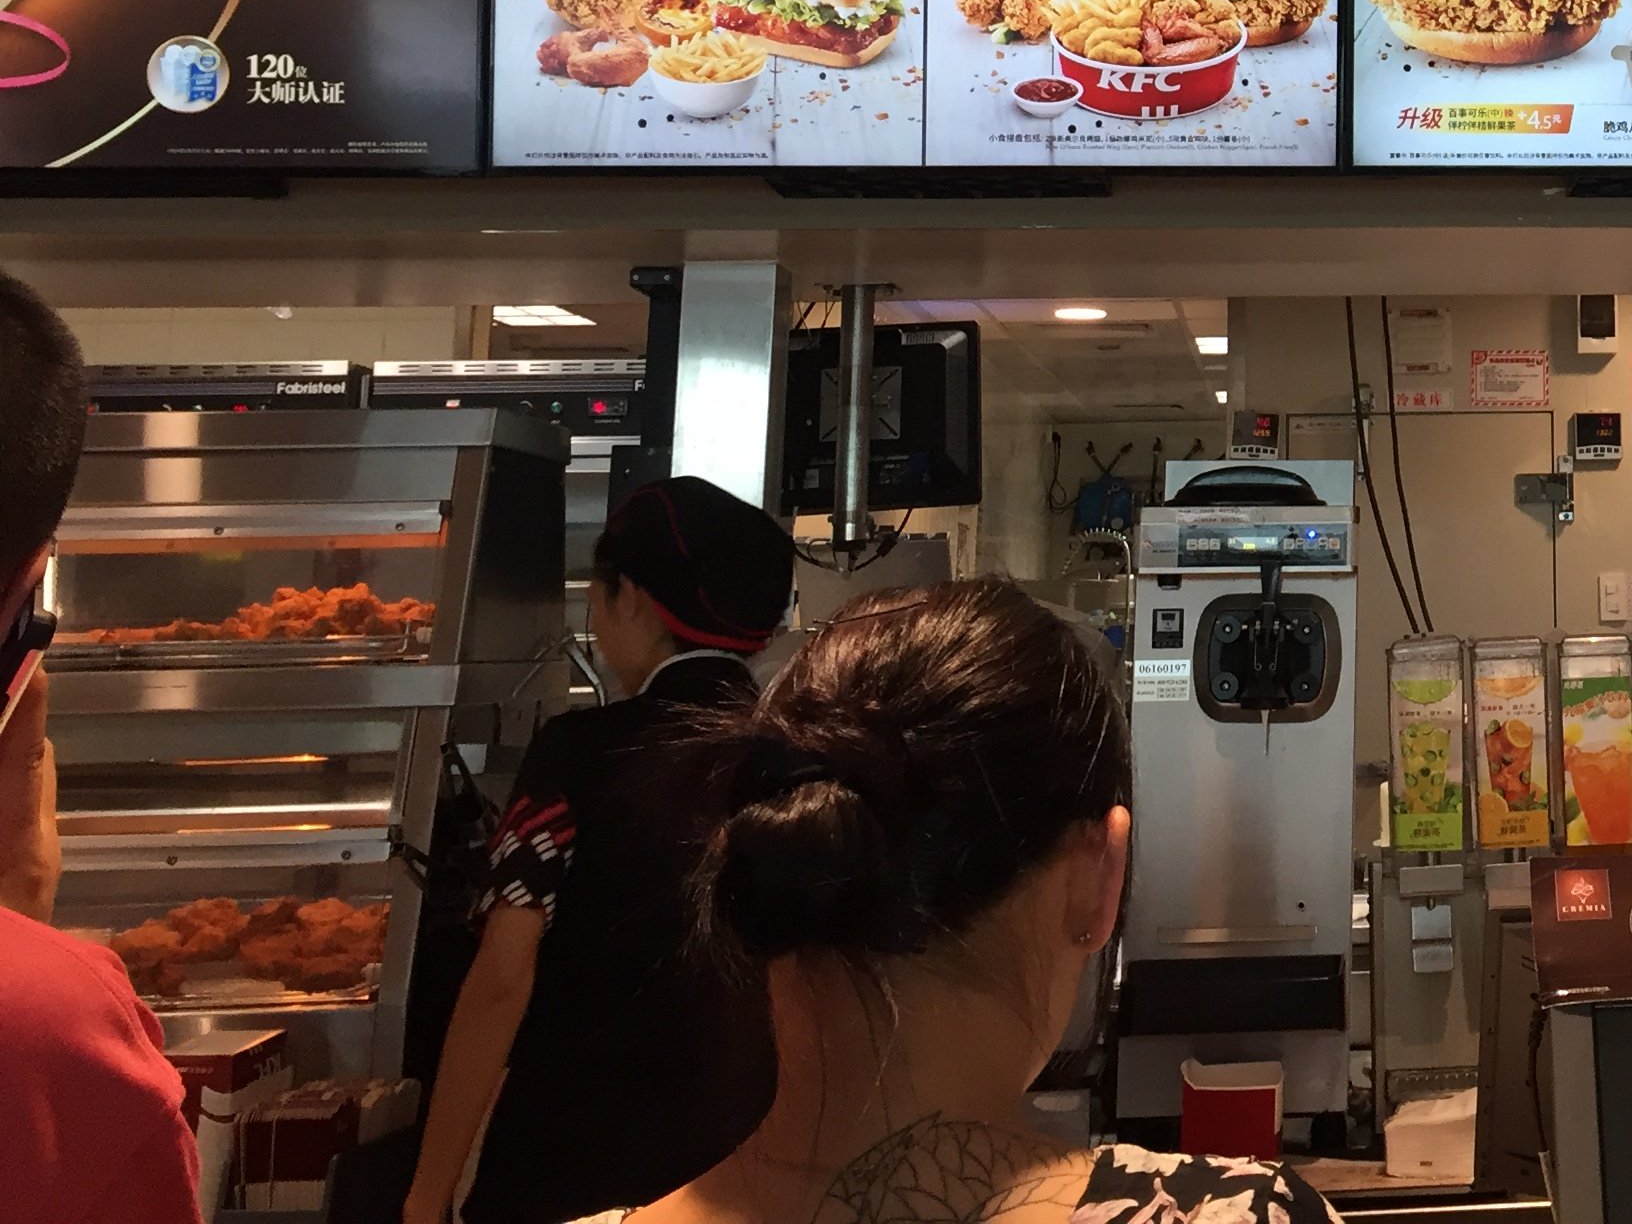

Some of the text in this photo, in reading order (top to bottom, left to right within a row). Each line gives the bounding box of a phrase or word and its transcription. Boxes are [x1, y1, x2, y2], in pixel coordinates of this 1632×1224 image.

[245, 53, 308, 79] 120位
[1096, 69, 1183, 93] KFC
[246, 81, 346, 105] 大师认证
[1396, 107, 1444, 130] 升级
[276, 380, 346, 395] Fabristeel
[1395, 392, 1443, 408] 冷藏库
[1138, 663, 1187, 674] 06160197
[1562, 903, 1606, 914] CREMIA
